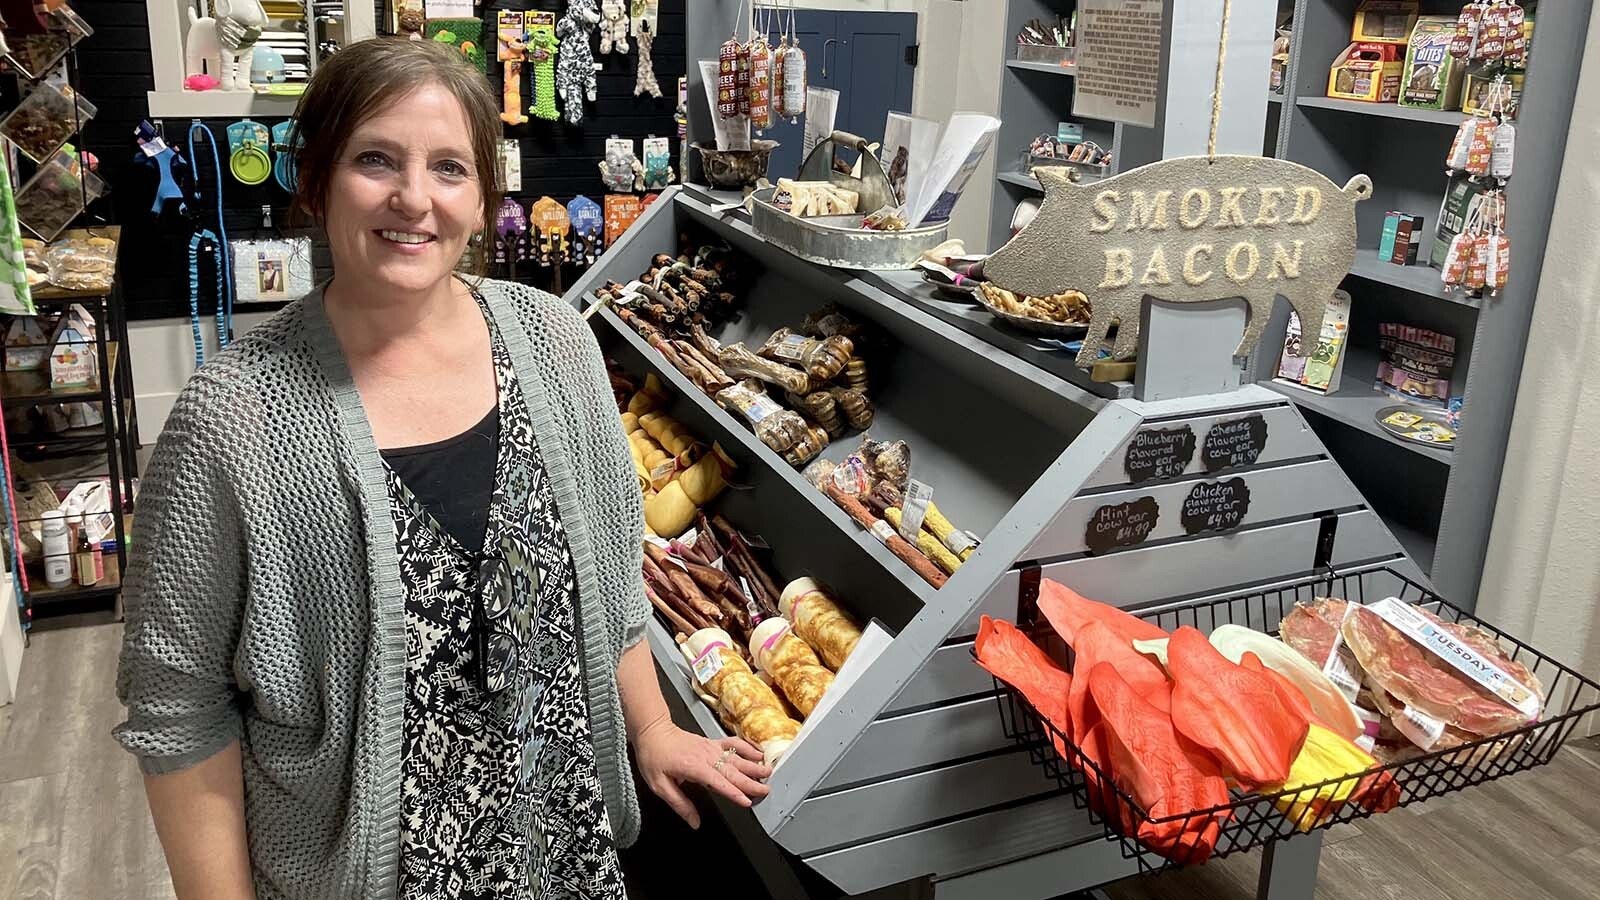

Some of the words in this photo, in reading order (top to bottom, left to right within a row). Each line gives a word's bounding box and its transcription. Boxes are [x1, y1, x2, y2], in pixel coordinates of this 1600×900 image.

[1416, 47, 1443, 62] BITES
[1090, 186, 1322, 233] SMOKED
[1098, 240, 1304, 289] BACON
[1136, 432, 1188, 447] Blueberry
[1192, 484, 1234, 499] Chicken
[1430, 630, 1502, 680] TUESDAY'S
